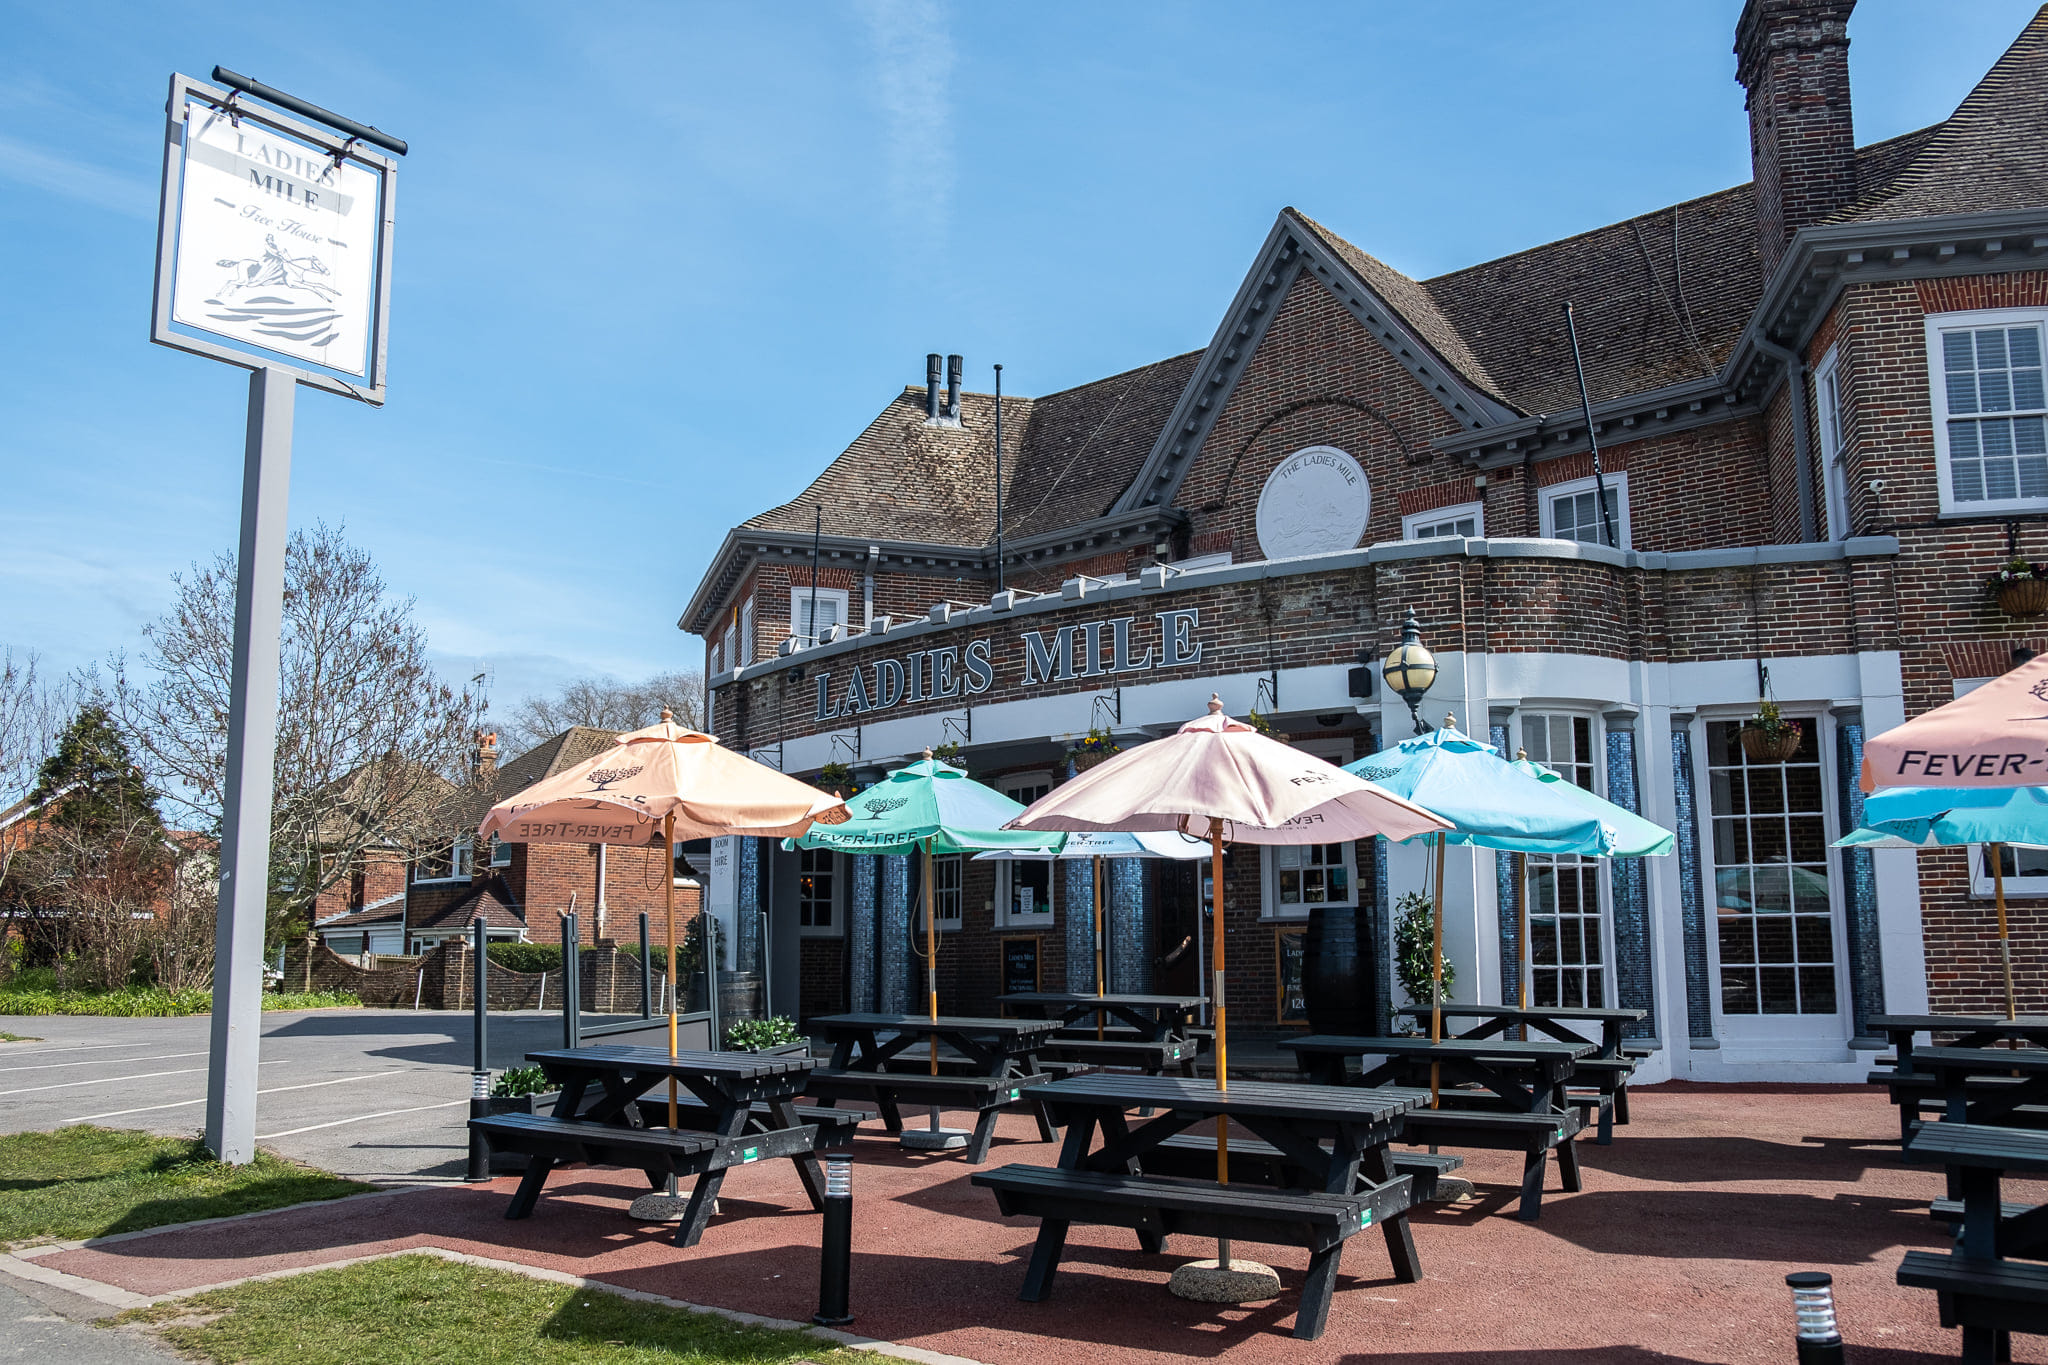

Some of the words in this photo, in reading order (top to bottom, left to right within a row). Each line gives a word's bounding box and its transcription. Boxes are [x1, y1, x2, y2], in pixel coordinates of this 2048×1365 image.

[236, 133, 336, 188] LADIES
[249, 168, 320, 212] MILE
[239, 204, 274, 227] Free
[278, 217, 323, 245] House
[1281, 462, 1301, 479] THE
[1304, 455, 1337, 467] LADIES
[1337, 462, 1357, 487] MILE
[814, 638, 994, 722] LADIES
[1020, 607, 1203, 686] MILE
[1897, 750, 2048, 777] FEVER-
[808, 831, 918, 845] FEVER-TREE
[714, 855, 728, 867] HIRE
